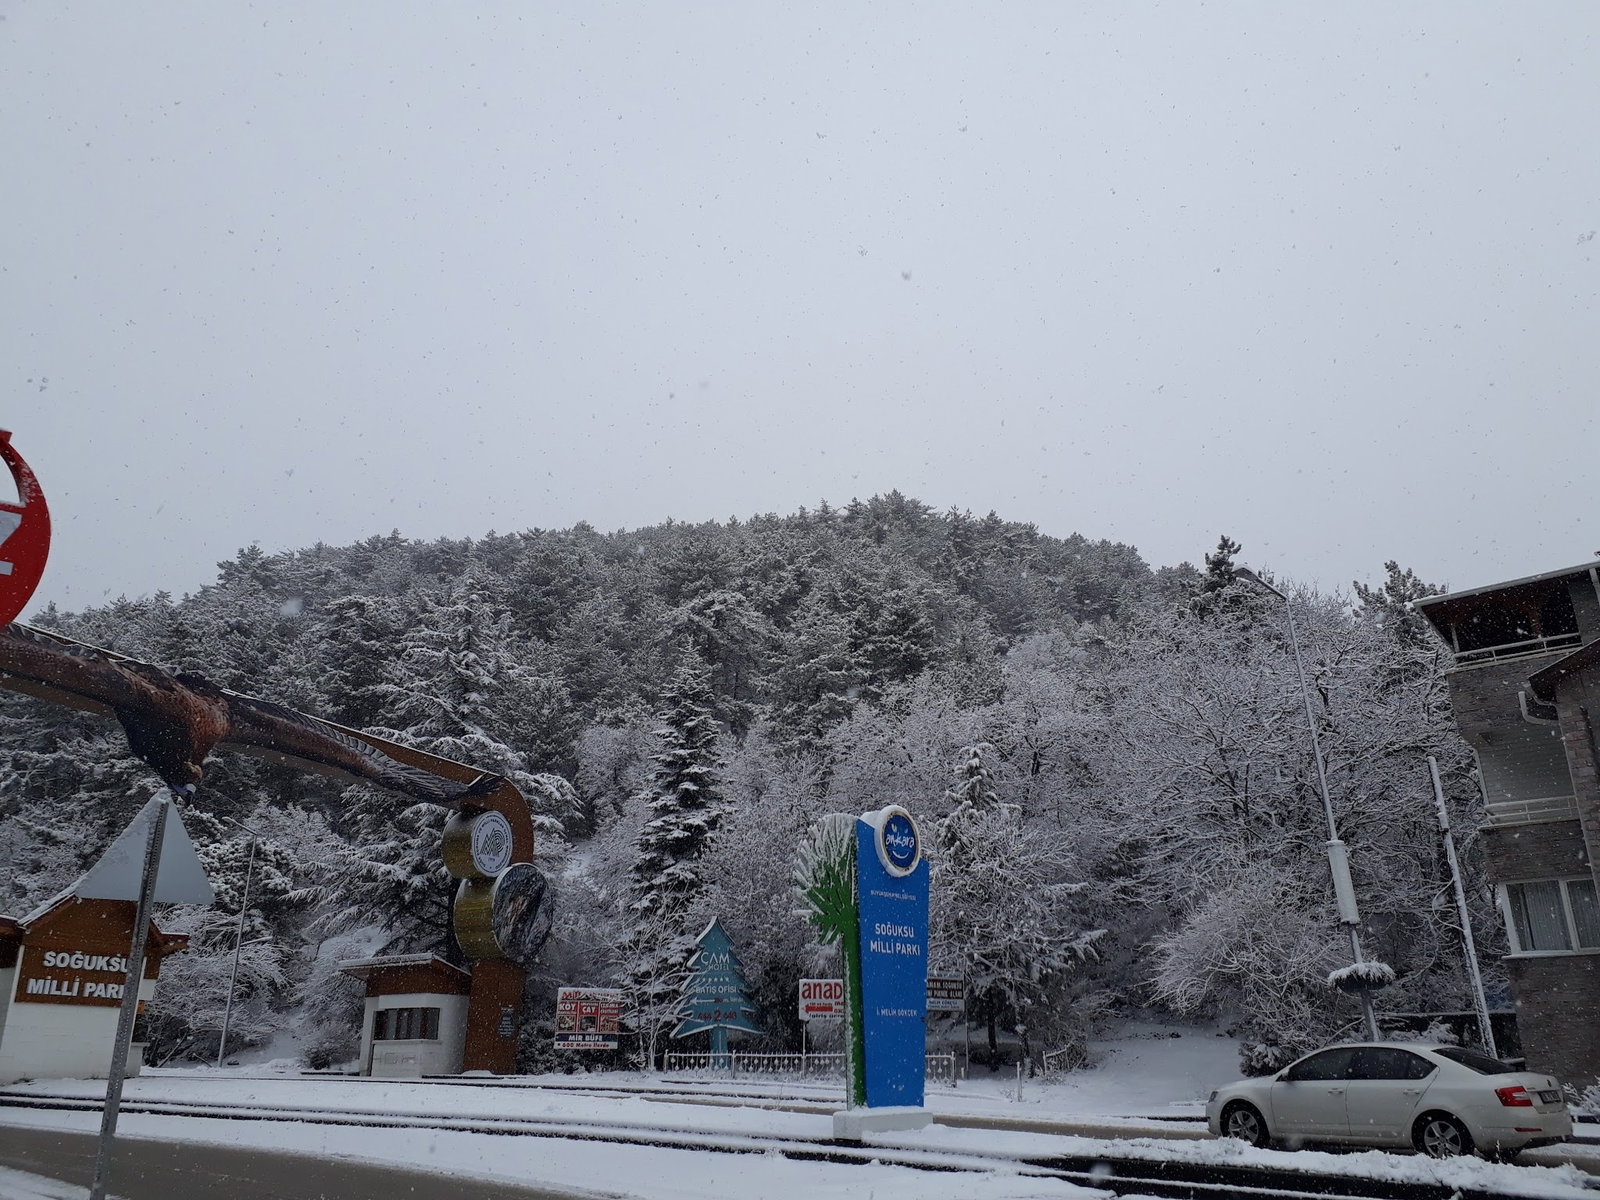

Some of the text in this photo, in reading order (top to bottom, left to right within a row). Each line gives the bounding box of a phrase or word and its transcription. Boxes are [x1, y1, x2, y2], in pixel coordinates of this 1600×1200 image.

[885, 831, 915, 849] ankara
[875, 922, 914, 938] SOĞUKSU
[870, 937, 920, 956] MİLLİ PARKI
[708, 963, 730, 971] HOTEL
[26, 976, 80, 997] MİLLİ
[717, 984, 737, 994] OFİSİ
[559, 1002, 577, 1011] KÖY
[582, 1005, 596, 1014] ÇAY
